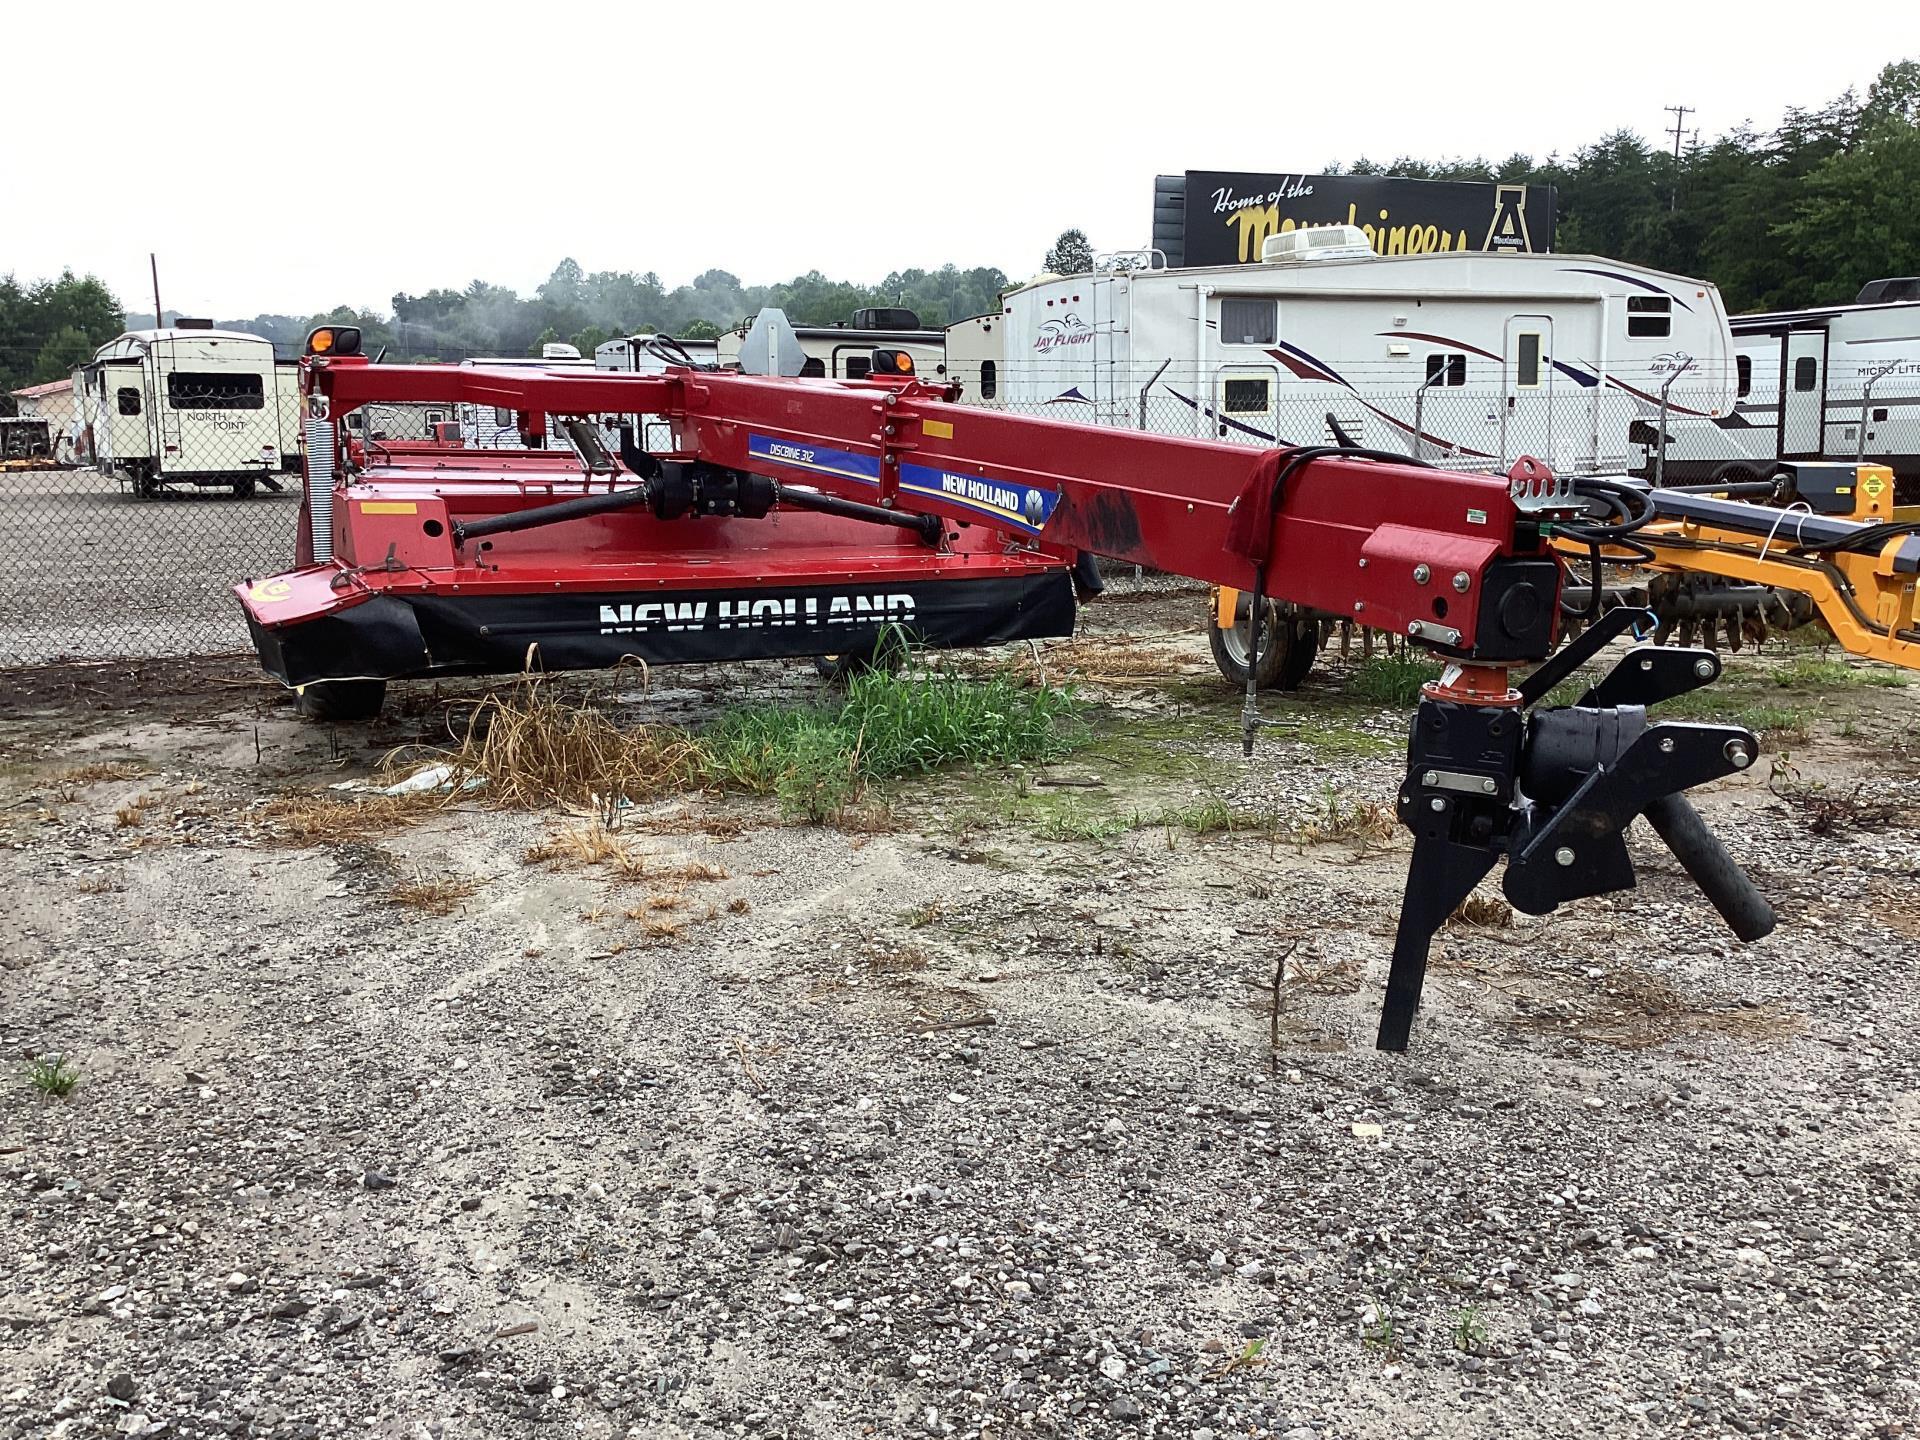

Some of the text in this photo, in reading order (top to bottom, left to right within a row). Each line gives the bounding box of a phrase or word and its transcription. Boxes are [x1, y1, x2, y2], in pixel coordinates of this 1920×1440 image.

[1211, 174, 1314, 213] Home of the
[1033, 333, 1095, 348] JAY FLIGHT
[1648, 363, 1700, 371] JAY FLIHT
[187, 412, 227, 421] NORTH
[213, 421, 246, 430] POINT
[770, 443, 815, 462] DISCBINE 312
[942, 473, 1019, 511] NEW HOLLAND
[600, 602, 708, 635] NEW
